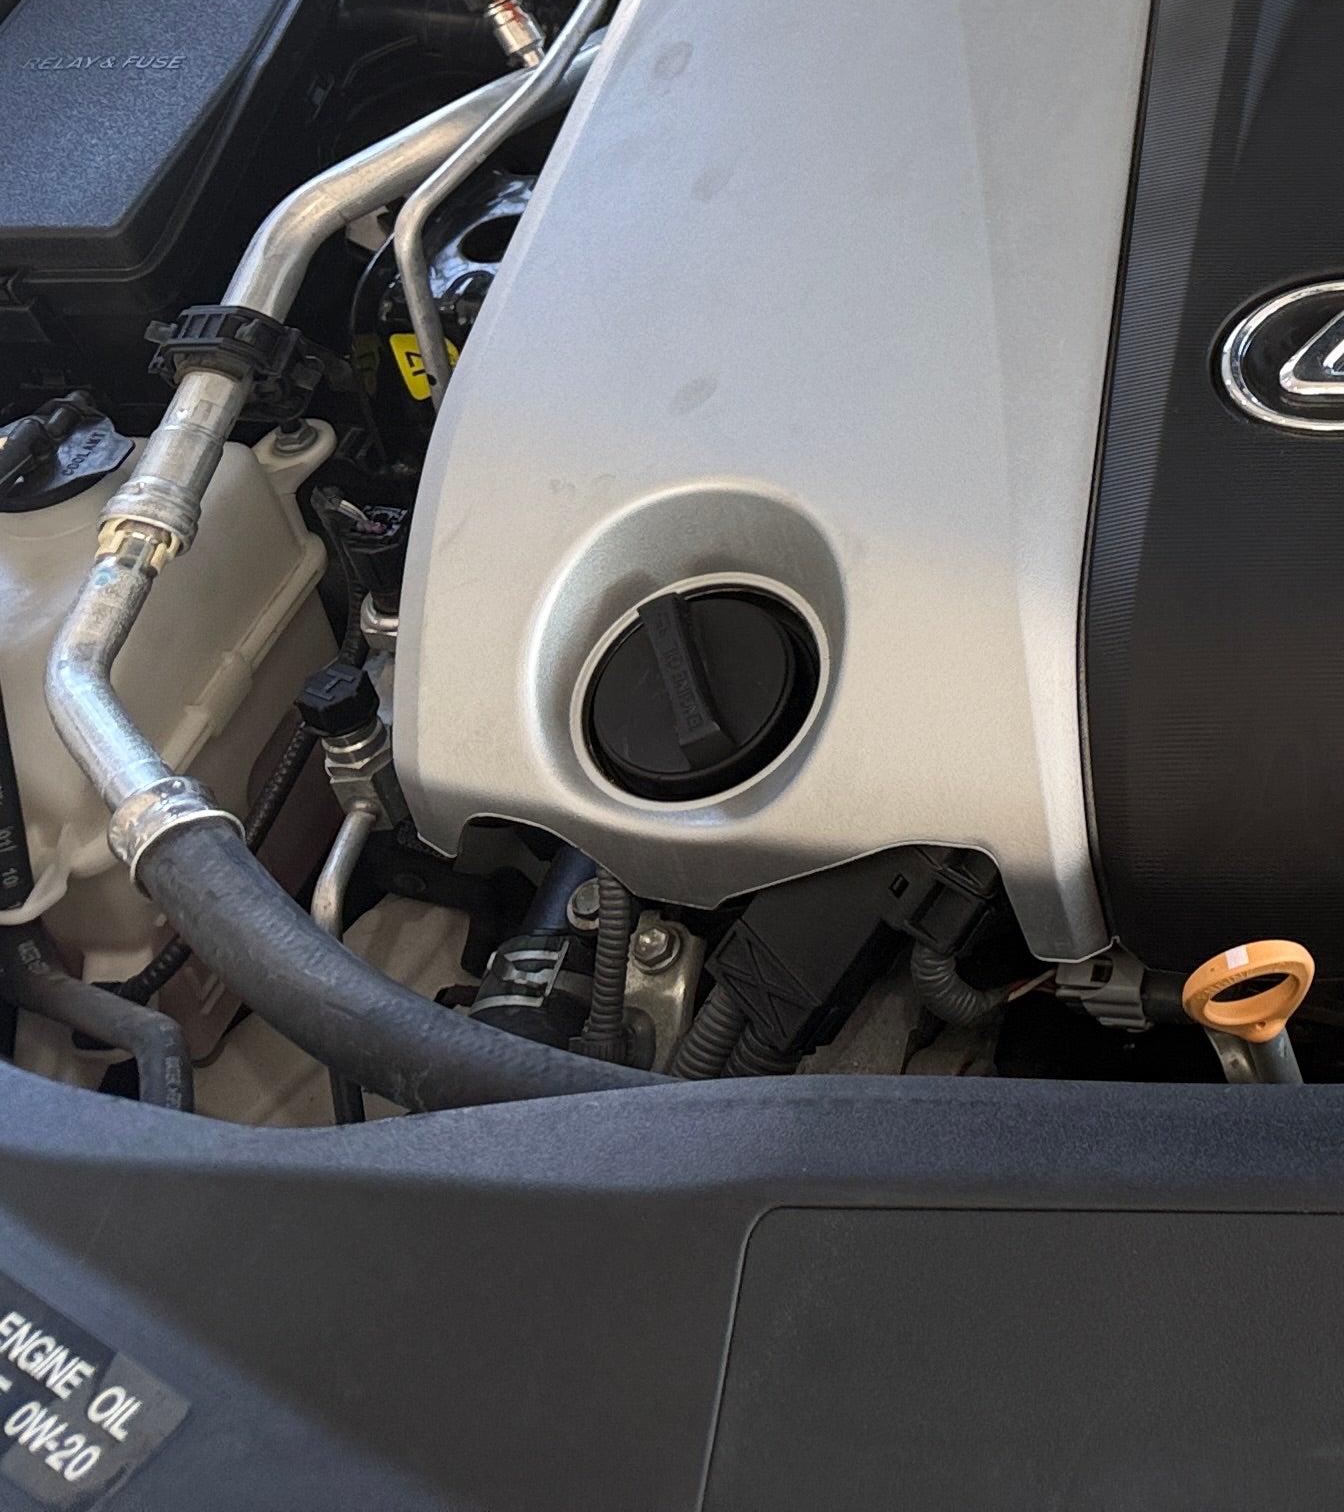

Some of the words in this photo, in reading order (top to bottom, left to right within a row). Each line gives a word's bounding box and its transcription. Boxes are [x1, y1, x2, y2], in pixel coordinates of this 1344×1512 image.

[22, 54, 97, 71] RELAY
[121, 55, 186, 70] FUSE
[62, 431, 105, 476] COOLANT
[0, 1311, 95, 1400] ENGINE
[87, 1385, 143, 1443] OIL
[4, 1400, 103, 1482] 0W-20
